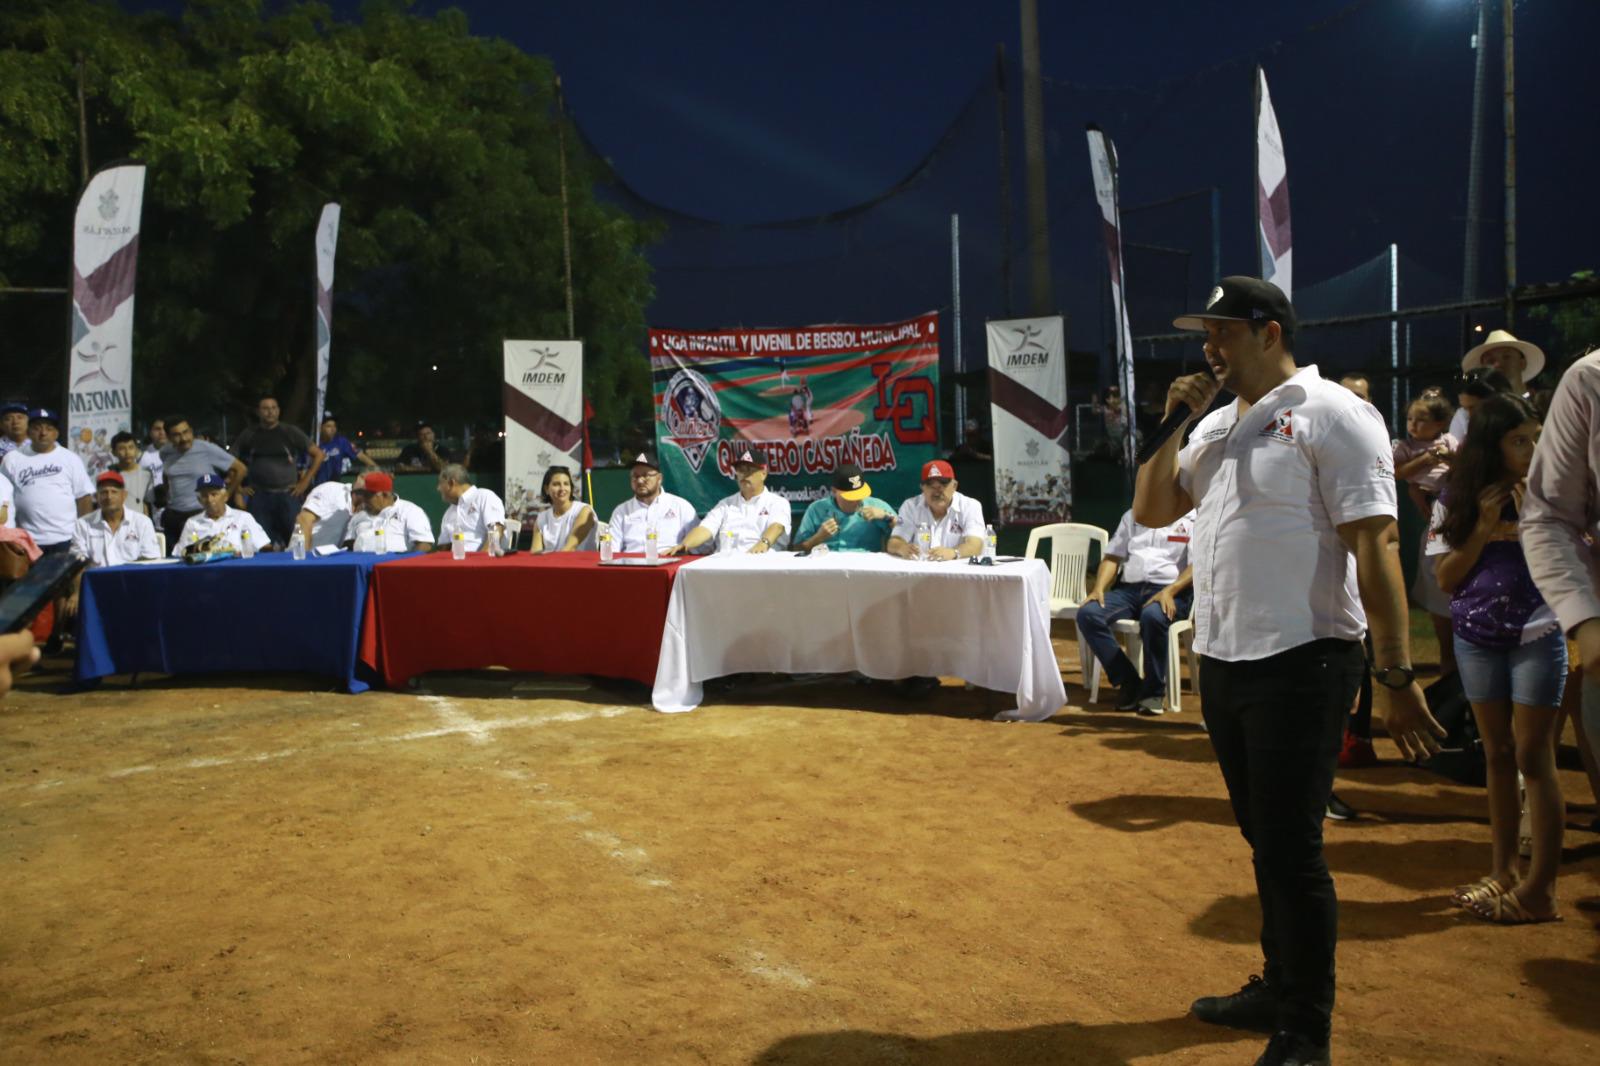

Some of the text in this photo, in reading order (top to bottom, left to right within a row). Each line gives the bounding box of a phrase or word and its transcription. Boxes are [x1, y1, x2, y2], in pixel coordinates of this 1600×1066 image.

[661, 323, 921, 356] LIGA INFANTIL Y JUVENIL DE BEISBOL MUNICIPAL
[1006, 352, 1049, 366] IMDEM
[521, 372, 566, 384] IMDEM
[802, 426, 897, 474] CASTAÑEDA
